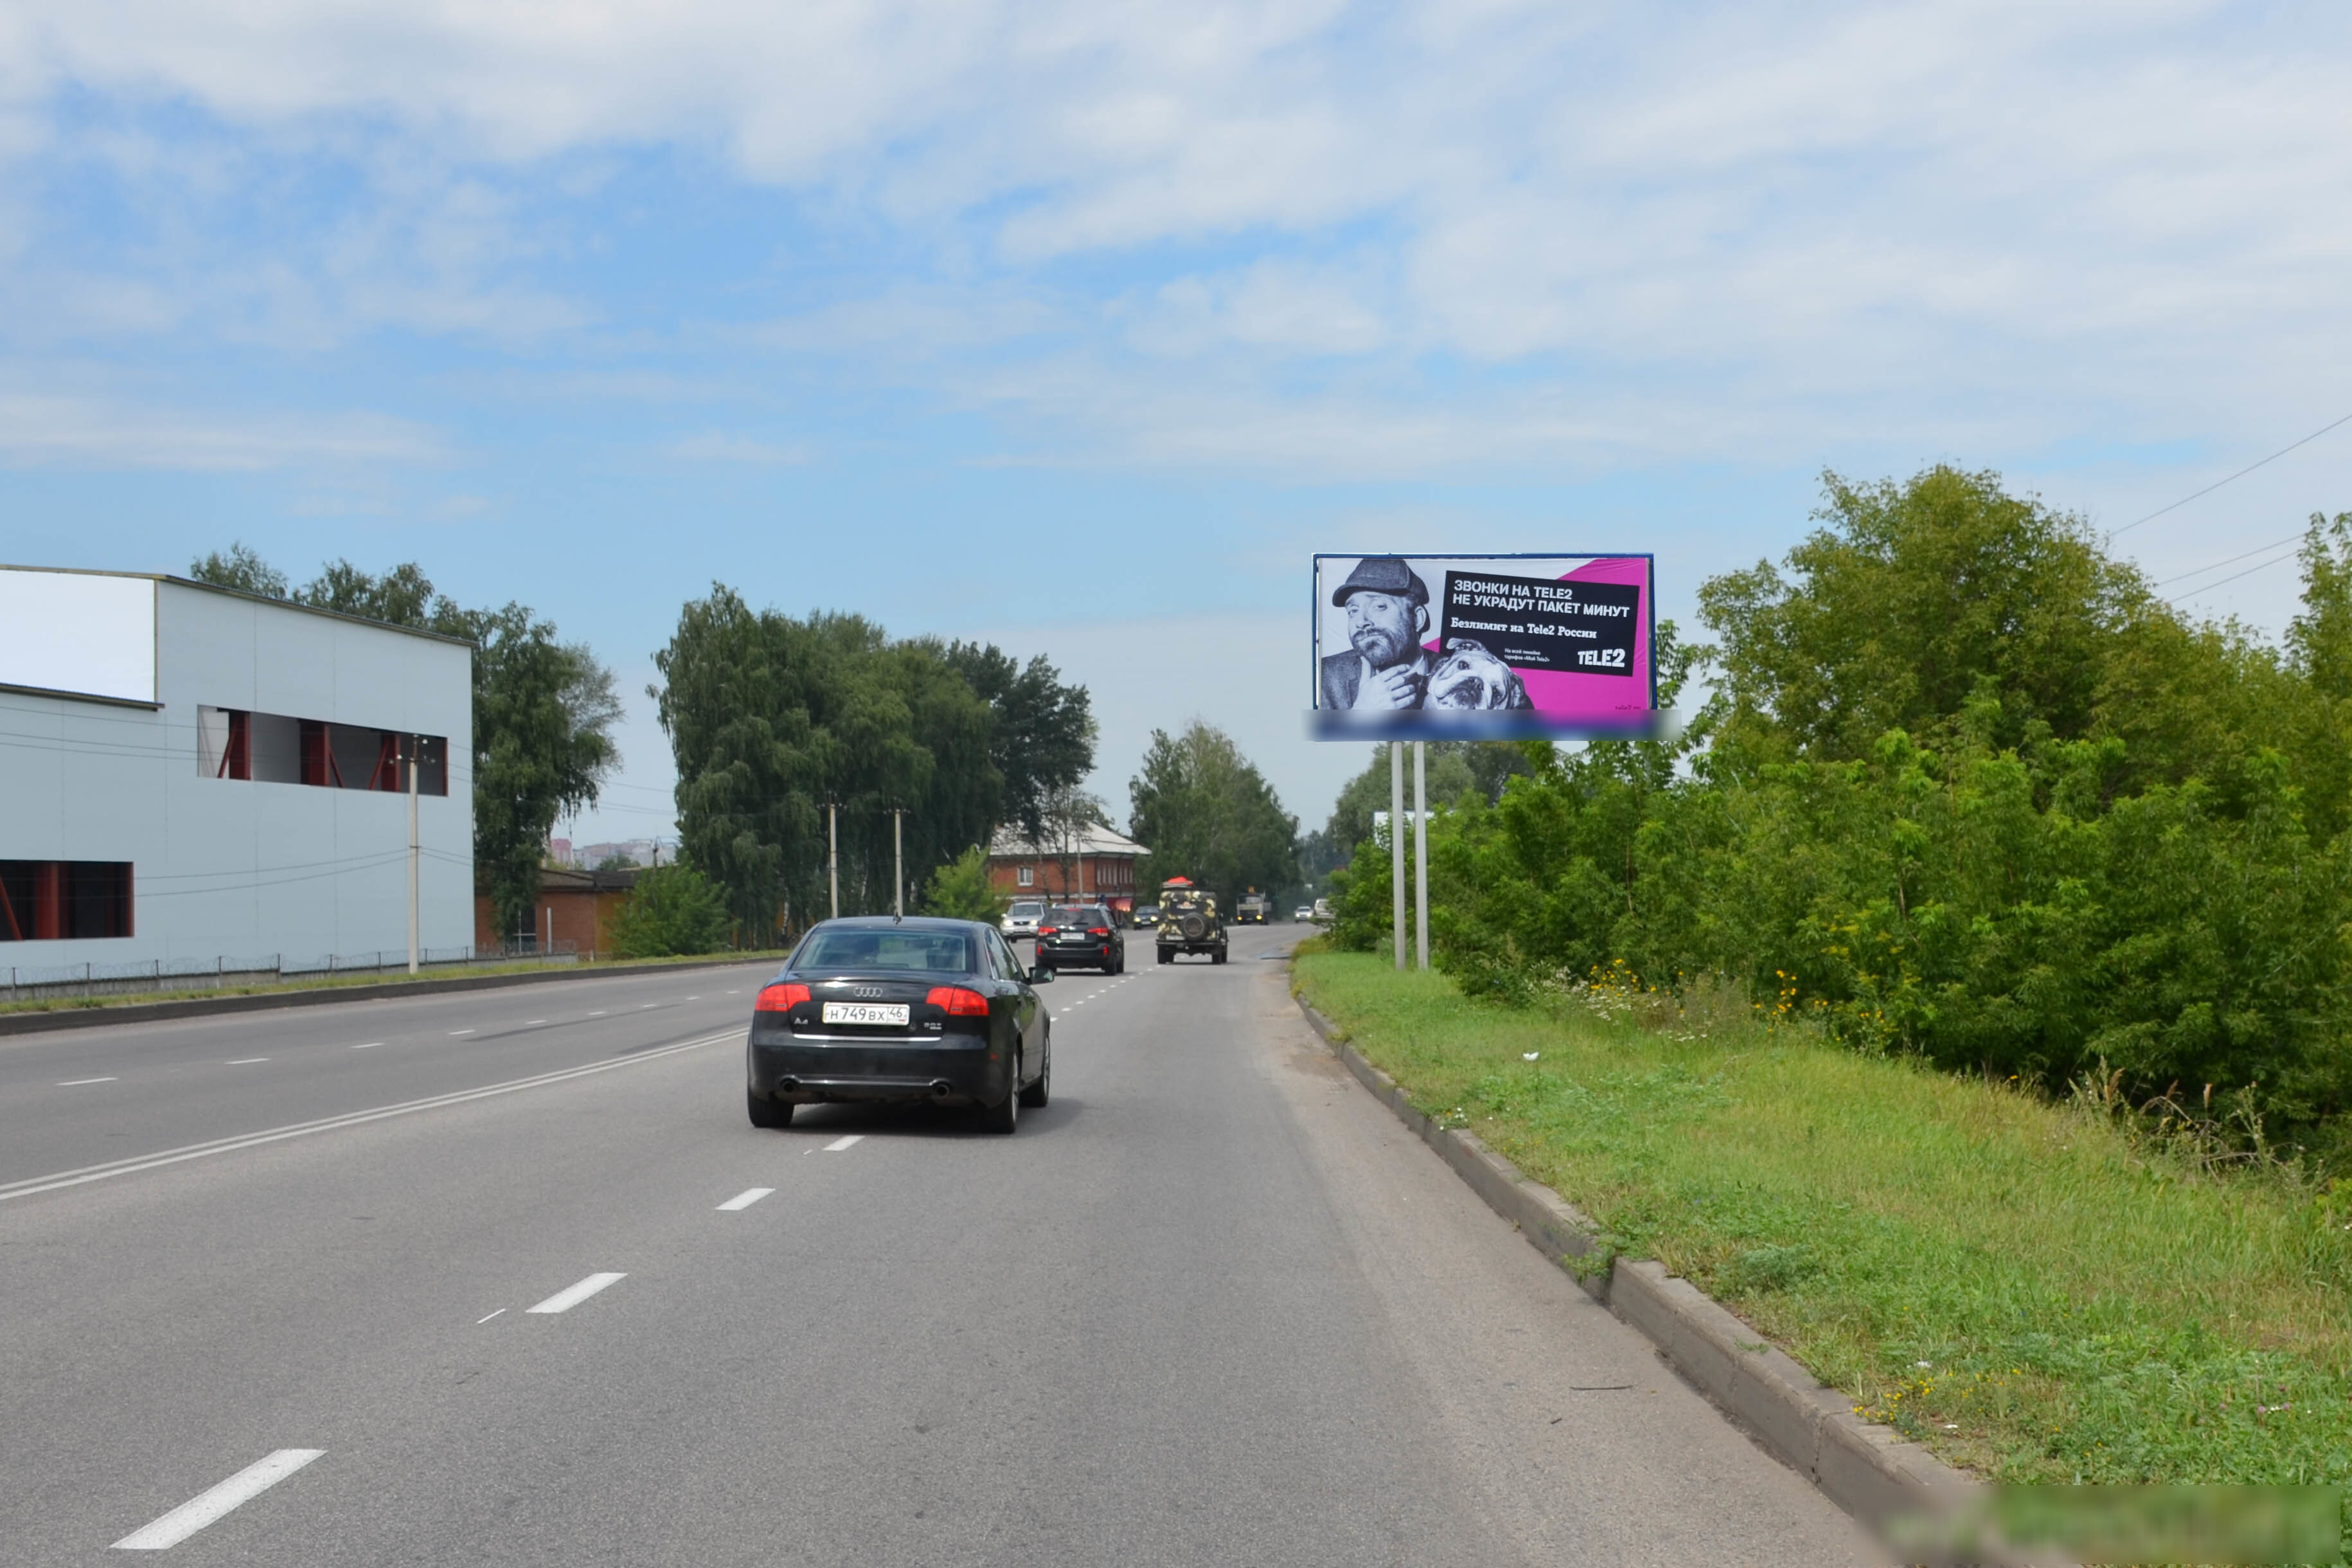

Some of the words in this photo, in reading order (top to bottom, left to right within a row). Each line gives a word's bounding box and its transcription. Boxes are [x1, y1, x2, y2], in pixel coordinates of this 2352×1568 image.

[1454, 580, 1508, 594] ЗВОНКИ
[1512, 585, 1530, 598] НА
[1534, 586, 1572, 600] TELE2
[1452, 594, 1470, 605] НЕ
[1474, 595, 1535, 612] УКРАДУТ
[1538, 600, 1580, 614] ПАКЕТ
[1583, 605, 1630, 618] МИНУТ
[1450, 617, 1508, 632] Безлимит
[1527, 623, 1555, 636] Tele2
[1558, 626, 1598, 639] России
[1578, 648, 1626, 668] TELE2
[889, 1008, 903, 1018] 46
